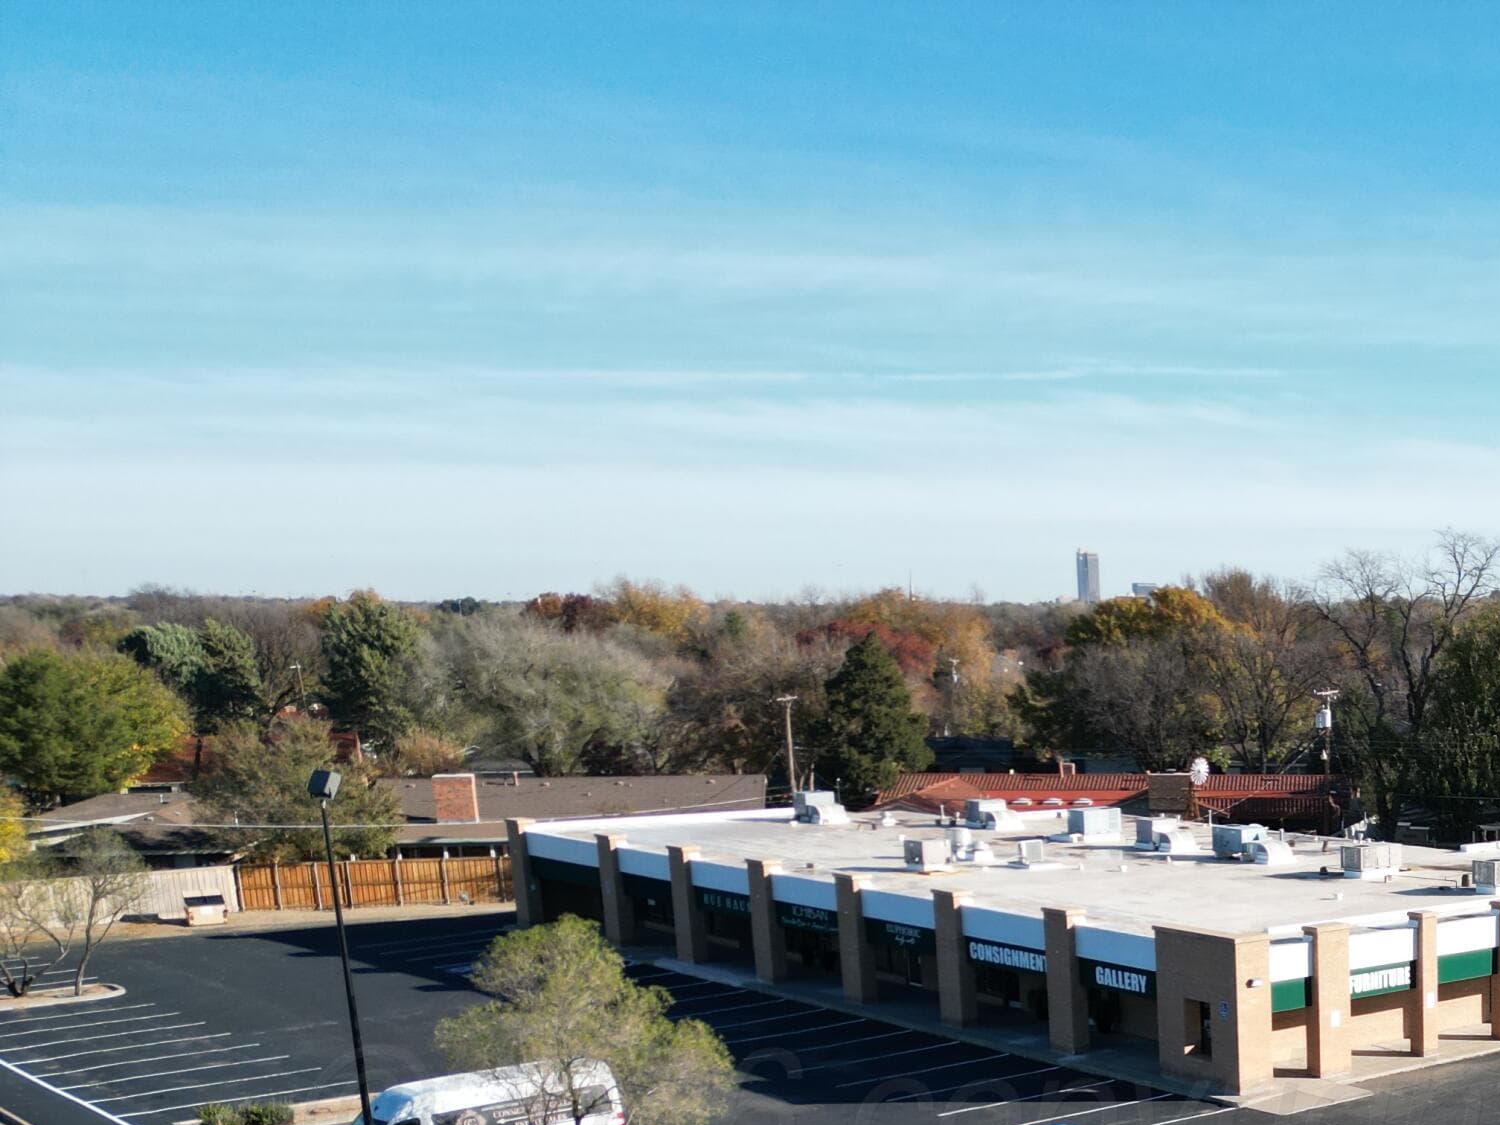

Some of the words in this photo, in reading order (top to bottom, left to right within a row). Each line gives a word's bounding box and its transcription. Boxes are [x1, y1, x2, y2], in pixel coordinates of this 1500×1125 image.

[969, 941, 1047, 973] CONSIGNMENT
[1095, 966, 1147, 993] GALLERY
[1350, 966, 1410, 994] FURNITURE
